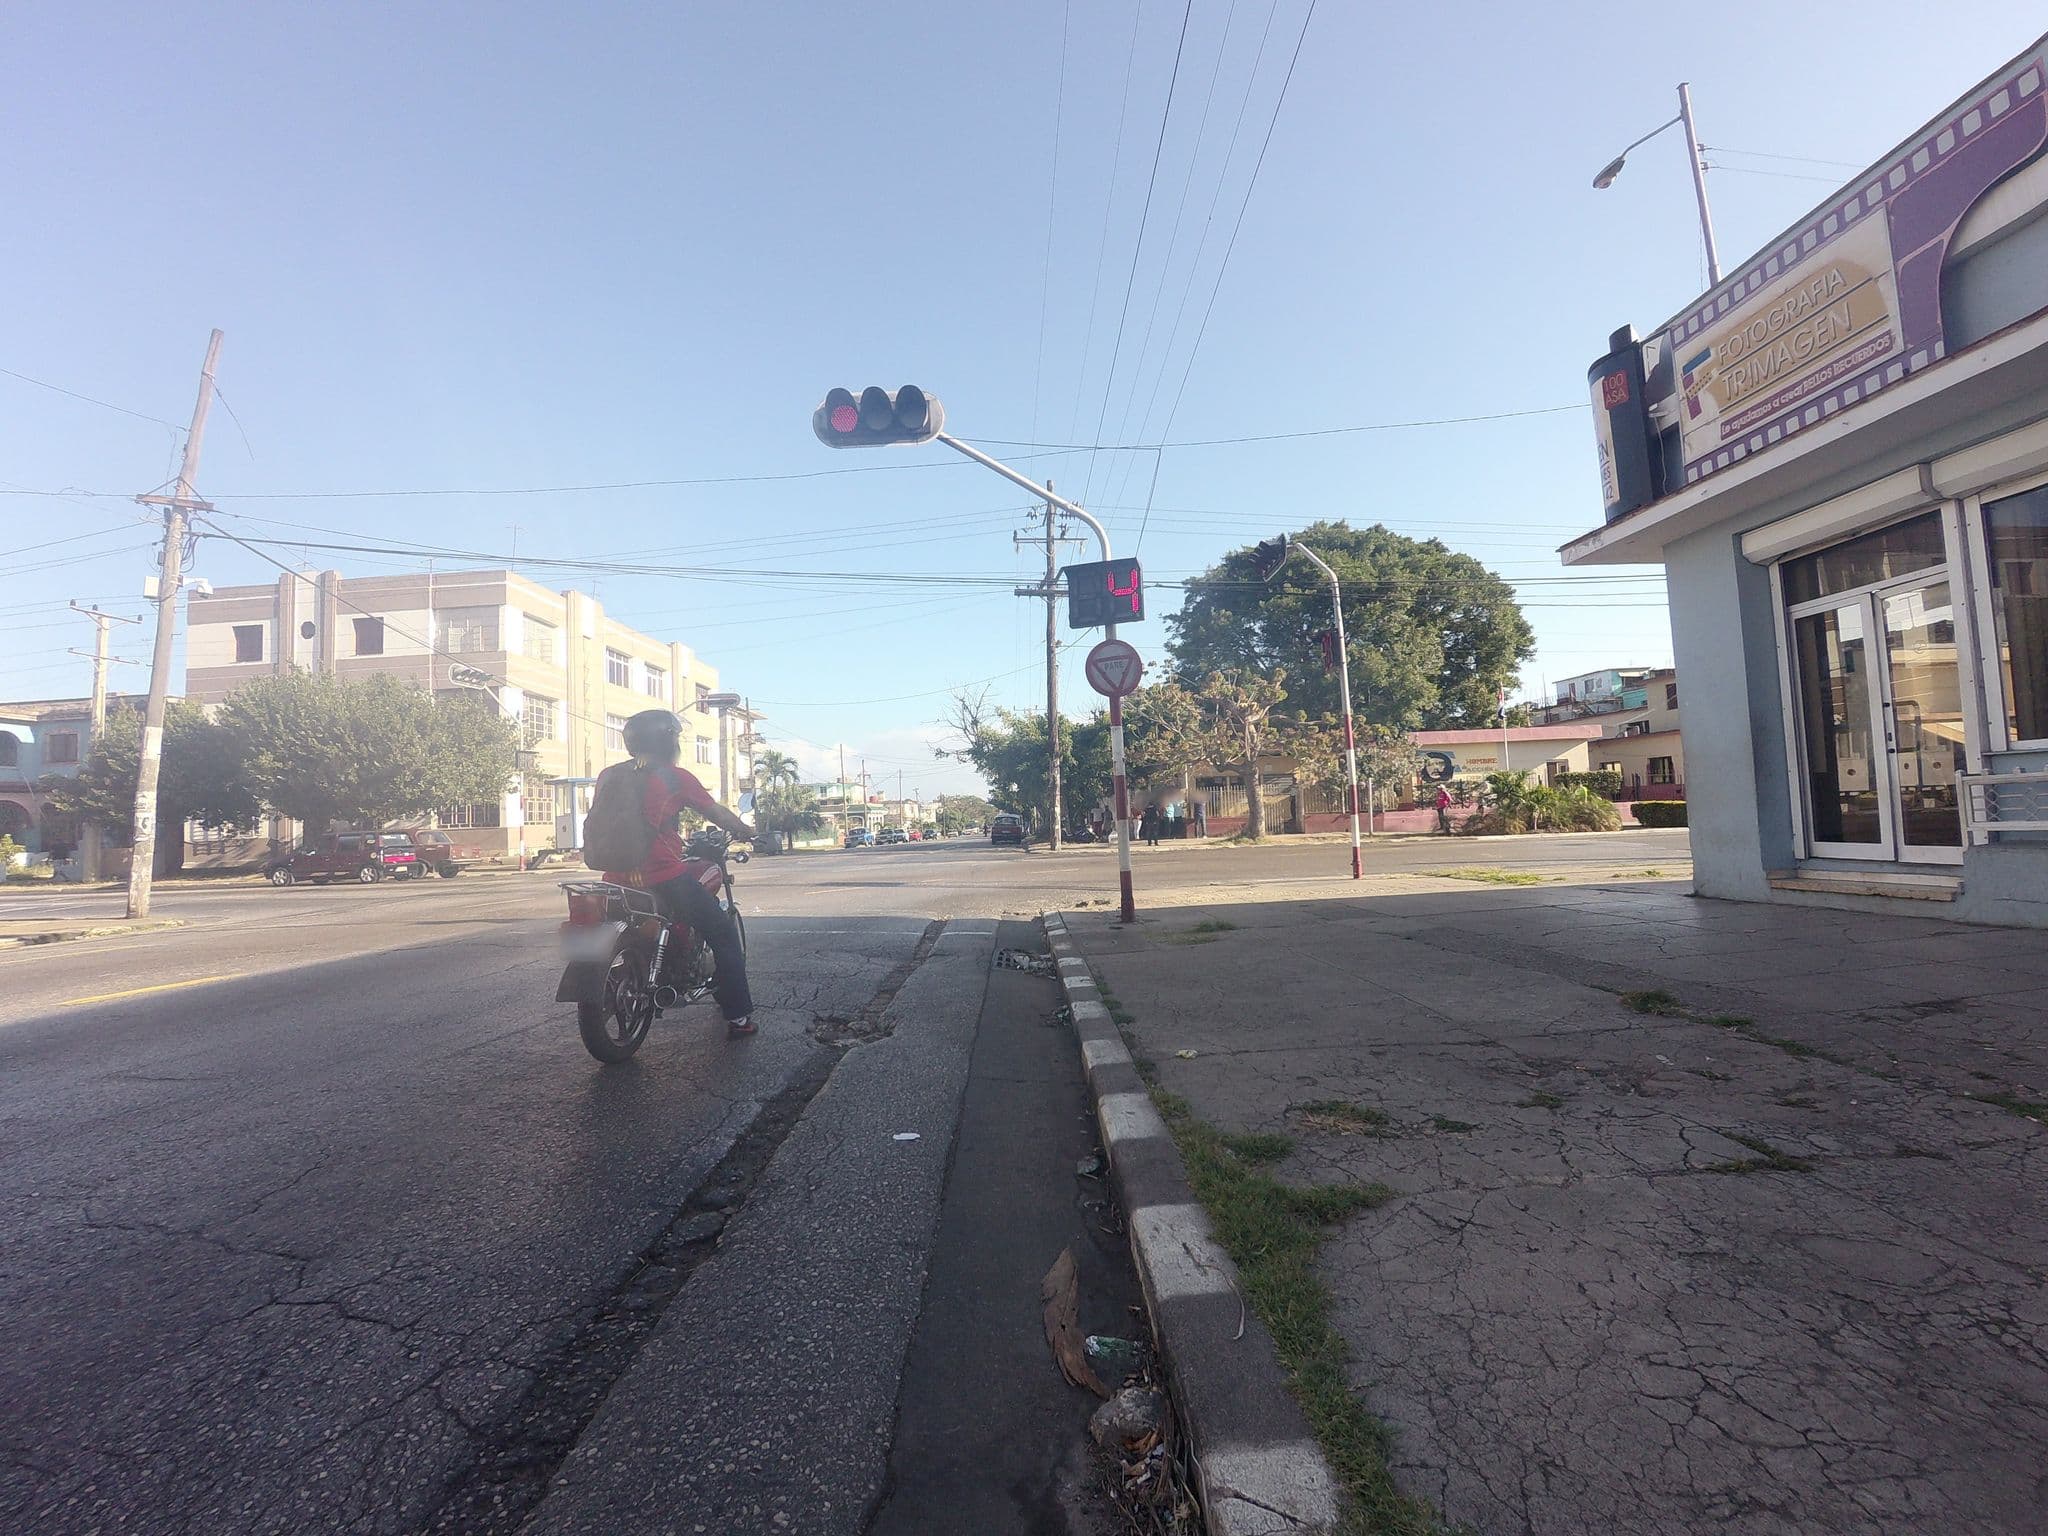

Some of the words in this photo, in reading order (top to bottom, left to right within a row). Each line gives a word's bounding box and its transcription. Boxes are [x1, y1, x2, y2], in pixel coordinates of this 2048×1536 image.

[1719, 268, 1847, 366] FOTOGRAFIA
[1721, 301, 1853, 401] TRIMAGEN
[1604, 373, 1623, 391] 100
[1606, 387, 1626, 403] ASA
[1731, 402, 1772, 430] ayudamos
[1833, 335, 1892, 375] RECUERDOS
[1107, 567, 1139, 614] 4
